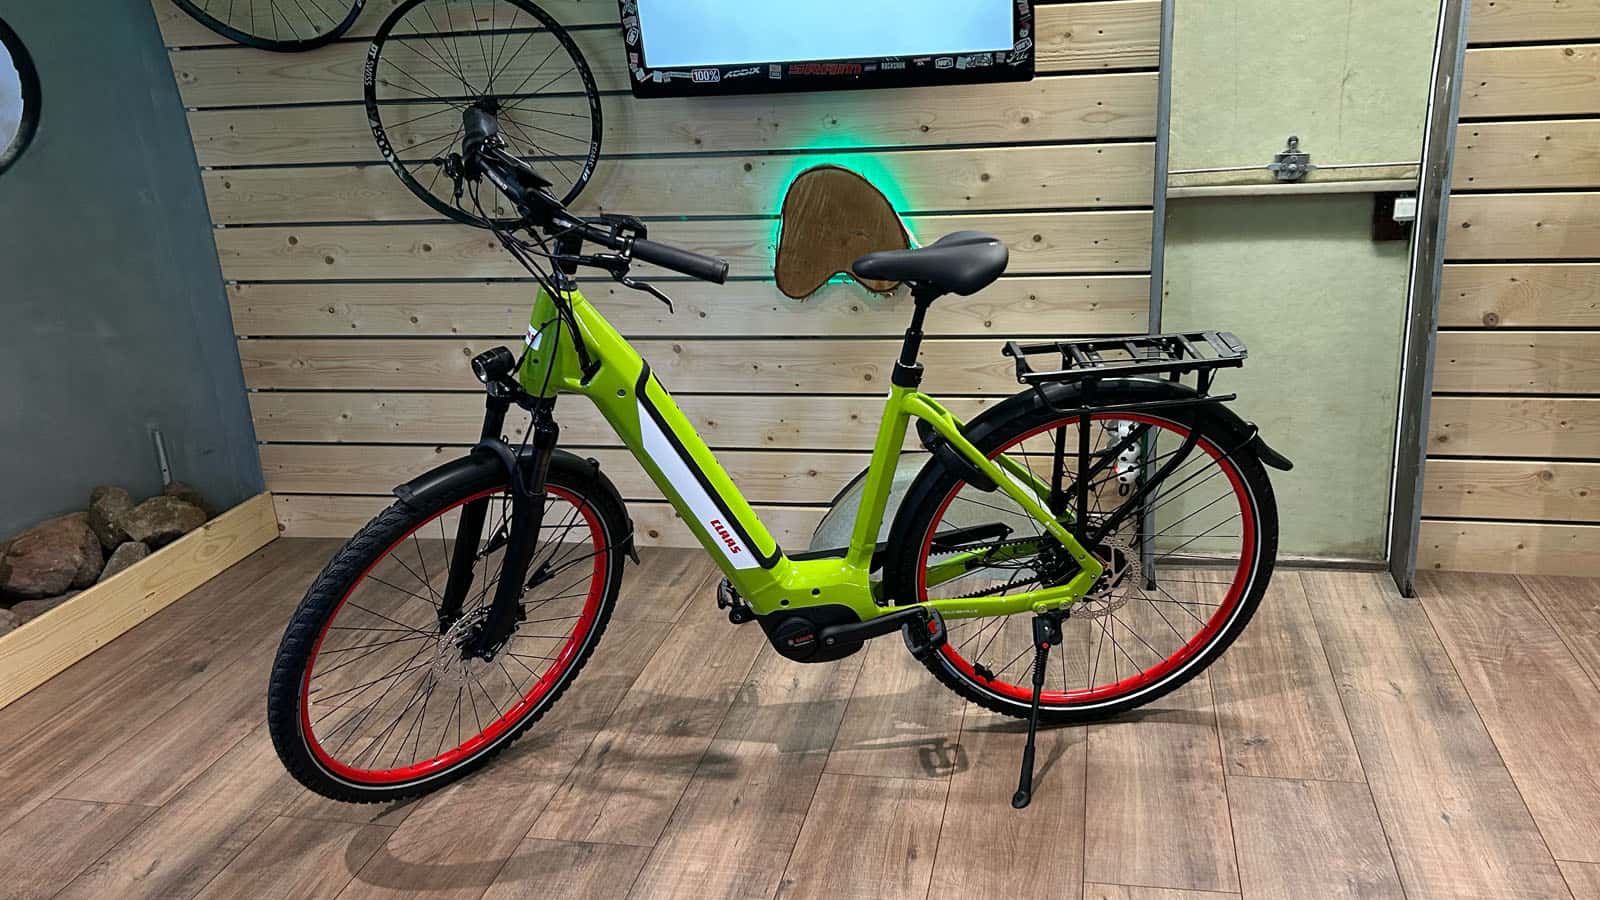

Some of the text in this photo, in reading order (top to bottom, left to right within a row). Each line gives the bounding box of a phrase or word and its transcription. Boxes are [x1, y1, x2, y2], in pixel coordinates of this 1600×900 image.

[364, 43, 378, 86] DT SWISS
[693, 69, 719, 81] 100%
[710, 519, 742, 554] CLAAS
